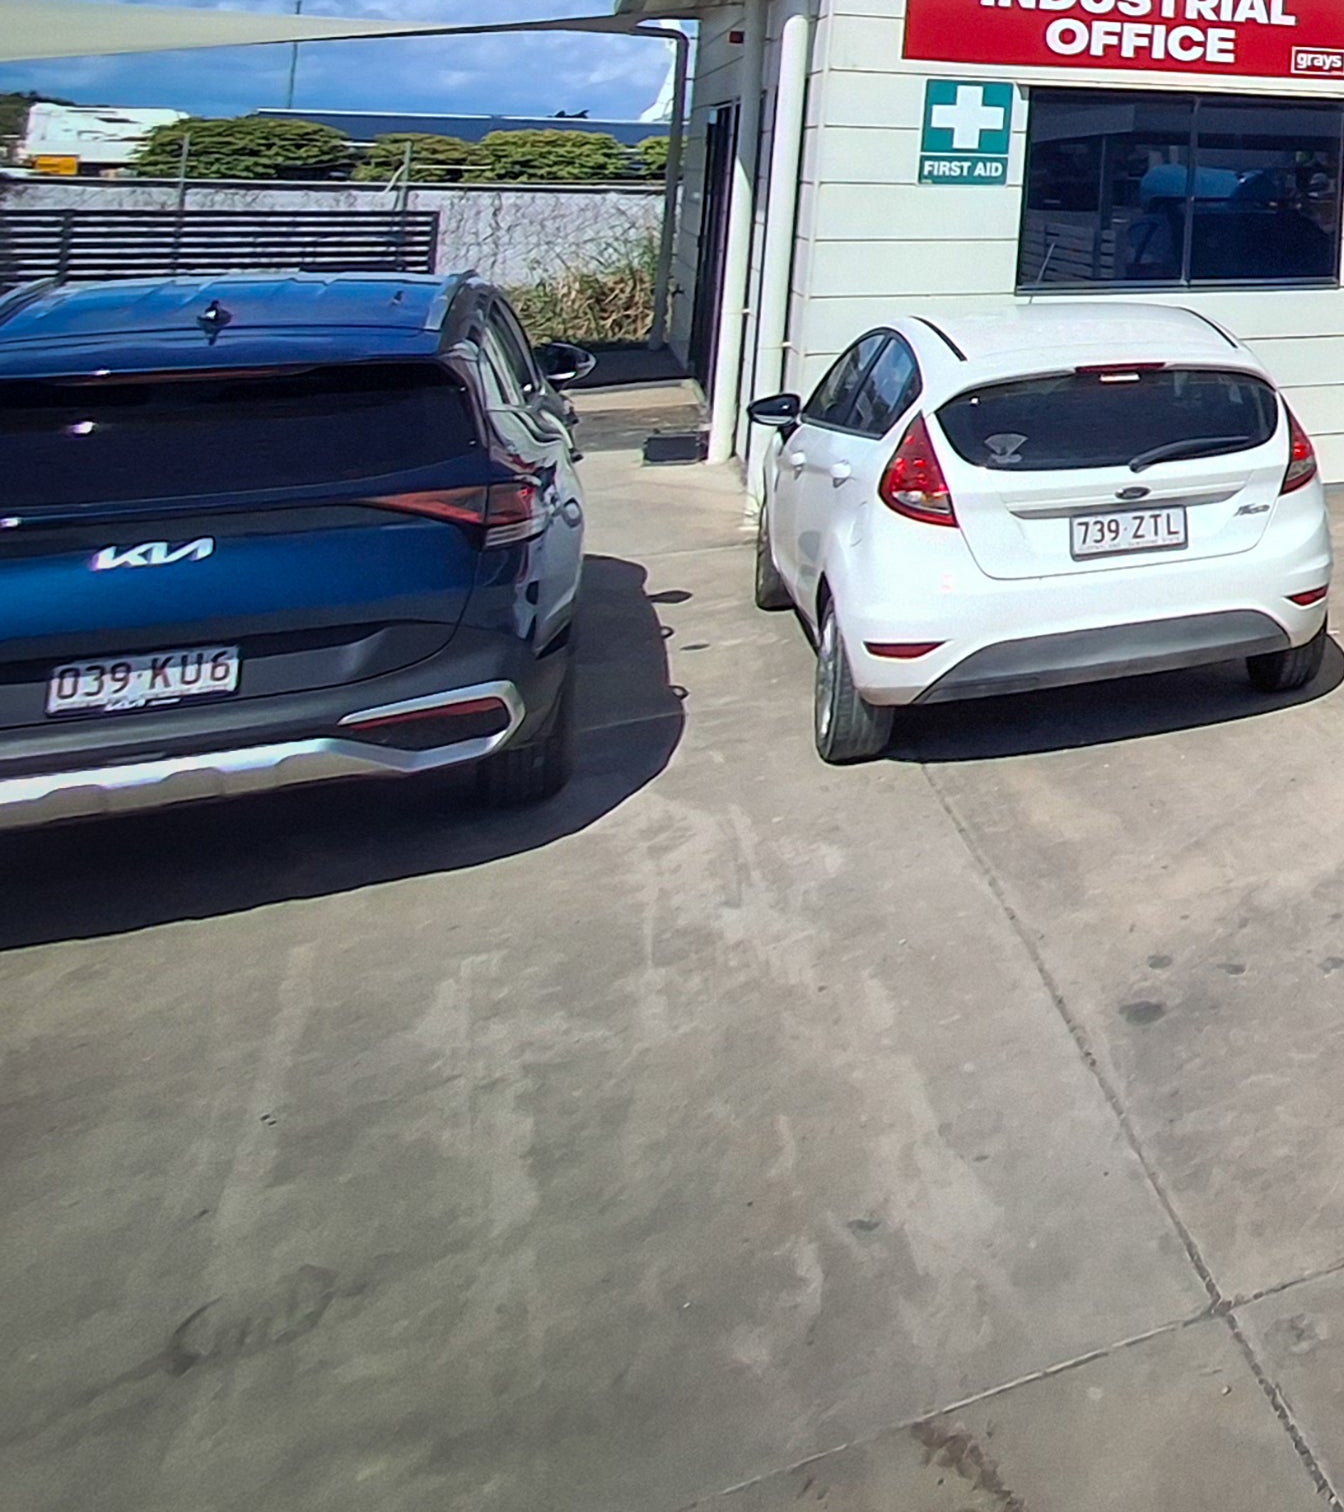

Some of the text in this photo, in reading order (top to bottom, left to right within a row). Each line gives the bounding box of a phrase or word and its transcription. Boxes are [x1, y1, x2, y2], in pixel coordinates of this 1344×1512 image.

[1045, 17, 1236, 64] OFFICE
[1296, 52, 1343, 71] grays
[923, 160, 1004, 177] FIRST AID
[89, 537, 214, 572] KIA
